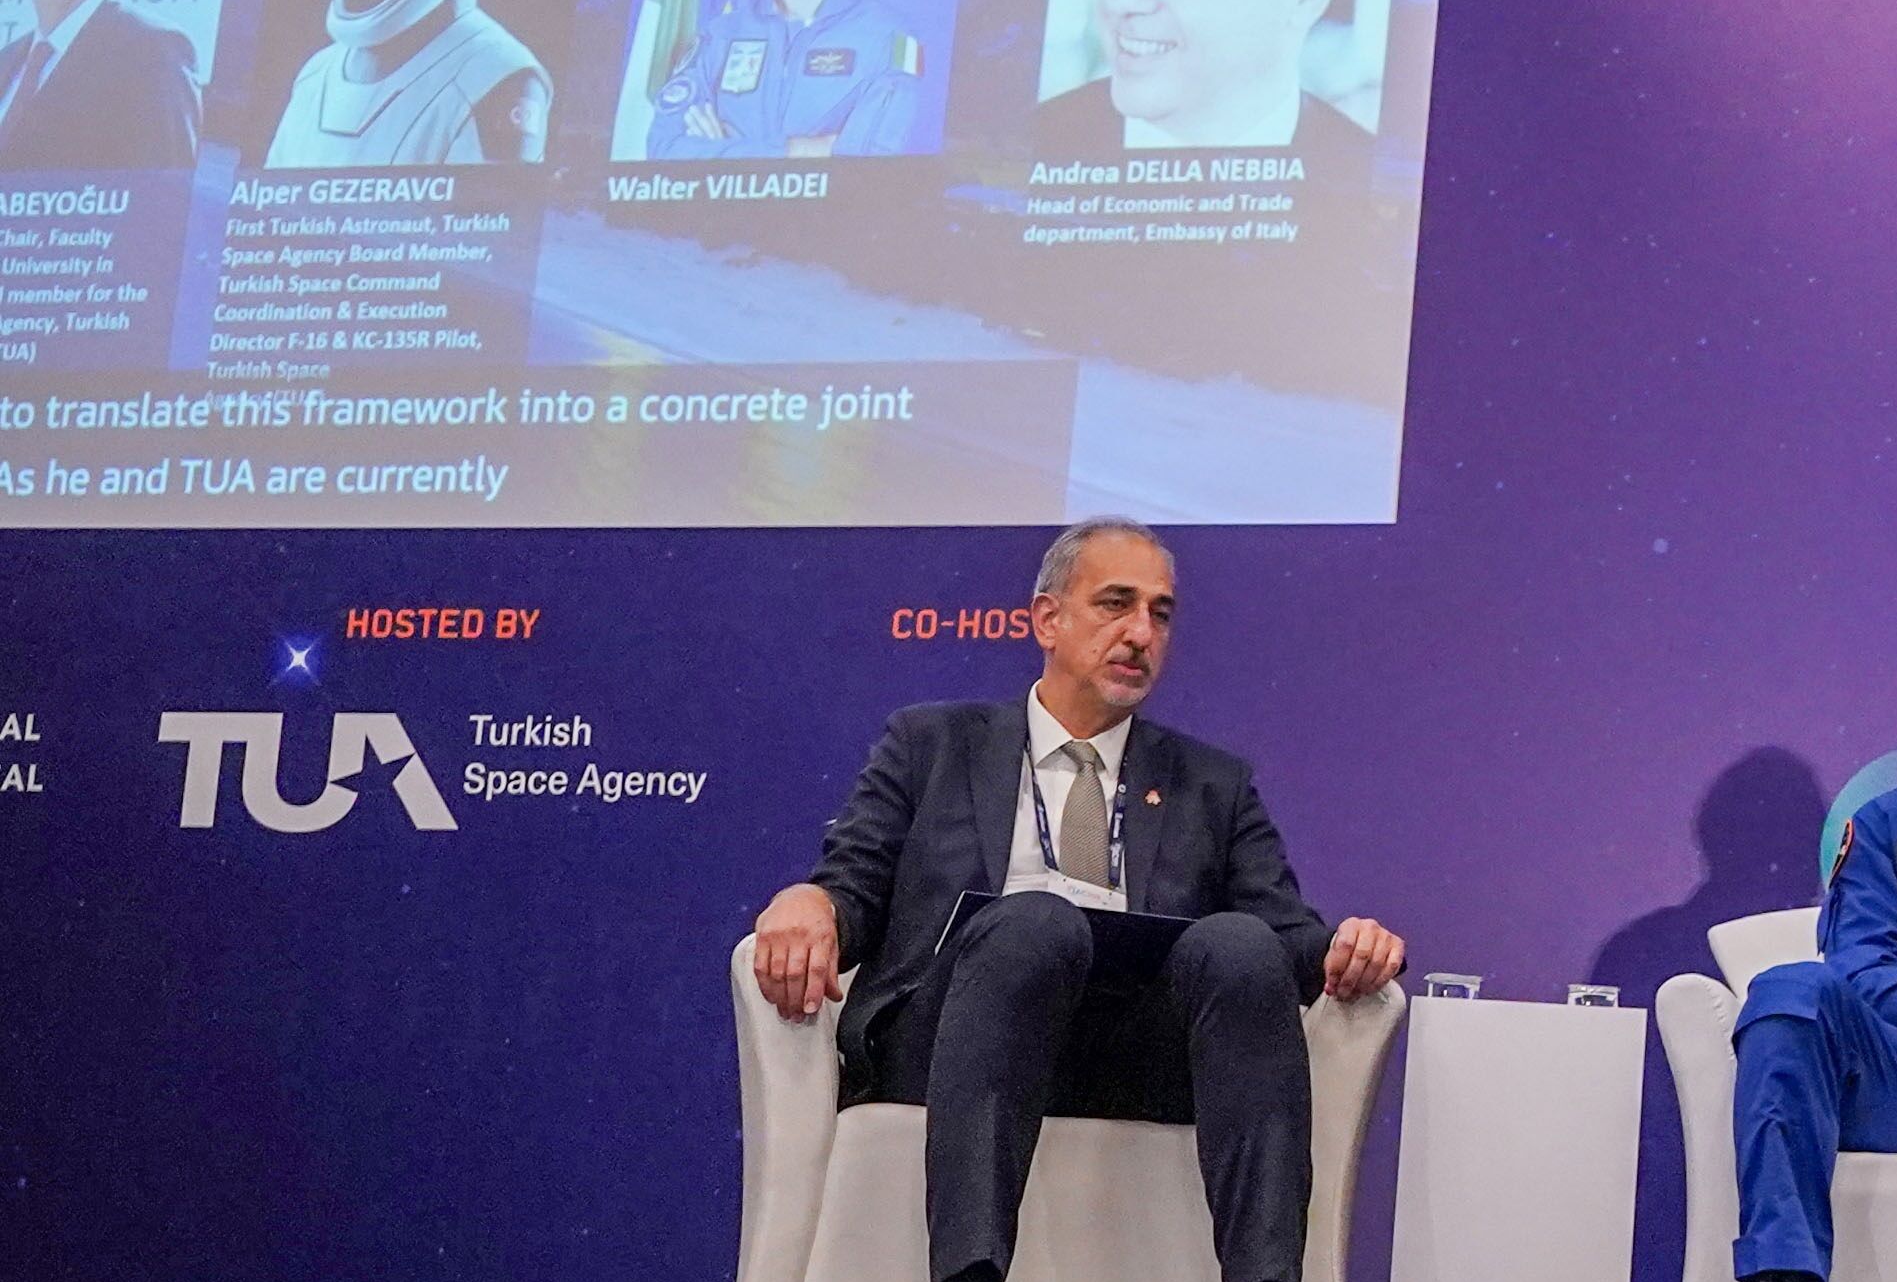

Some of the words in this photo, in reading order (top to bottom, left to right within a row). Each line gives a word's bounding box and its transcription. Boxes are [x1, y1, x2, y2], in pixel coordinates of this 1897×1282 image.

[1030, 159, 1119, 185] Andrea
[1127, 159, 1202, 183] DELLA
[1209, 157, 1304, 181] NEBBIA
[230, 180, 302, 211] Alper
[309, 177, 455, 204] GEZERAVCI
[608, 175, 698, 201] Walter
[705, 174, 828, 200] VILLADEI
[1026, 196, 1073, 214] Head
[1079, 195, 1099, 213] of
[1103, 194, 1194, 214] Economic
[1198, 194, 1233, 213] and
[1239, 193, 1293, 212] Trade
[1024, 221, 1140, 244] department,
[1145, 221, 1227, 243] Embassy
[1232, 220, 1253, 240] of
[1256, 219, 1298, 242] Italy
[46, 392, 209, 430] translate
[223, 390, 291, 426] this
[304, 388, 507, 426] framework
[520, 388, 595, 424] into
[605, 394, 628, 423] a
[639, 389, 807, 423] concrete
[816, 385, 913, 430] joint
[47, 459, 90, 495] he
[101, 459, 170, 495] and
[180, 460, 256, 495] TUA
[266, 465, 326, 494] are
[337, 455, 509, 501] currently
[346, 609, 485, 640] HOSTED
[496, 609, 540, 639] BY
[891, 608, 1031, 640] CO-HOS
[469, 714, 592, 747] Turkish
[158, 711, 459, 831] TUA
[462, 764, 568, 798] Space
[575, 764, 706, 802] Agency
